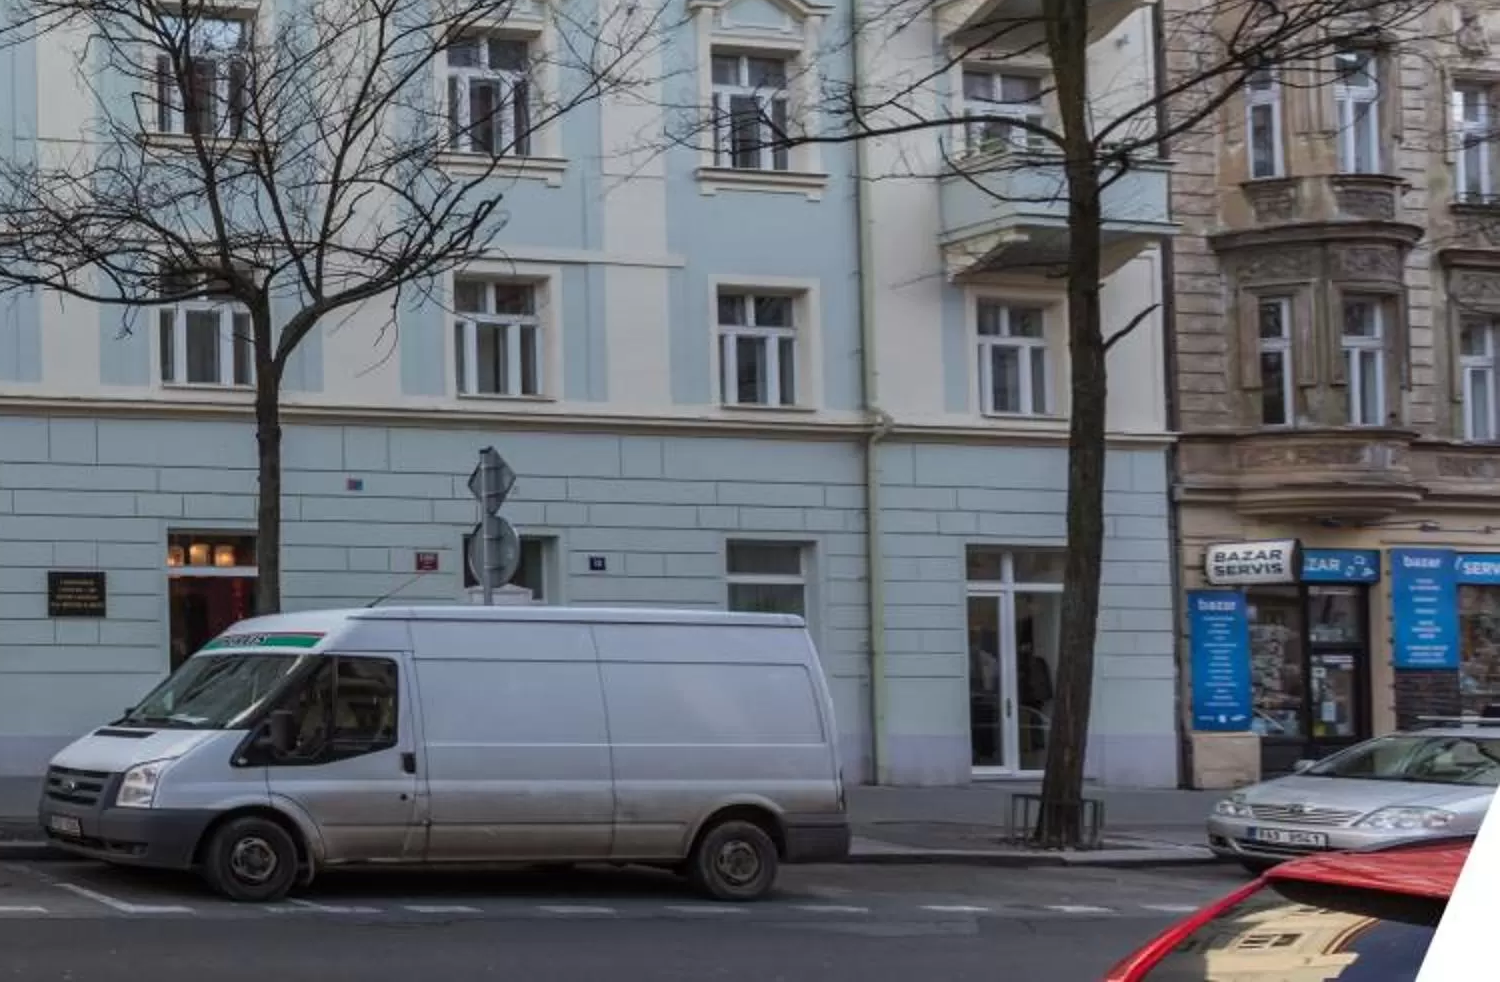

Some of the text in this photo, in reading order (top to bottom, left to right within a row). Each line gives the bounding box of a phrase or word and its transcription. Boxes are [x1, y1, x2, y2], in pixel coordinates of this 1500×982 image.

[1214, 549, 1283, 563] BAZAR
[1214, 563, 1284, 577] SERVIS
[1303, 557, 1341, 571] ZAR
